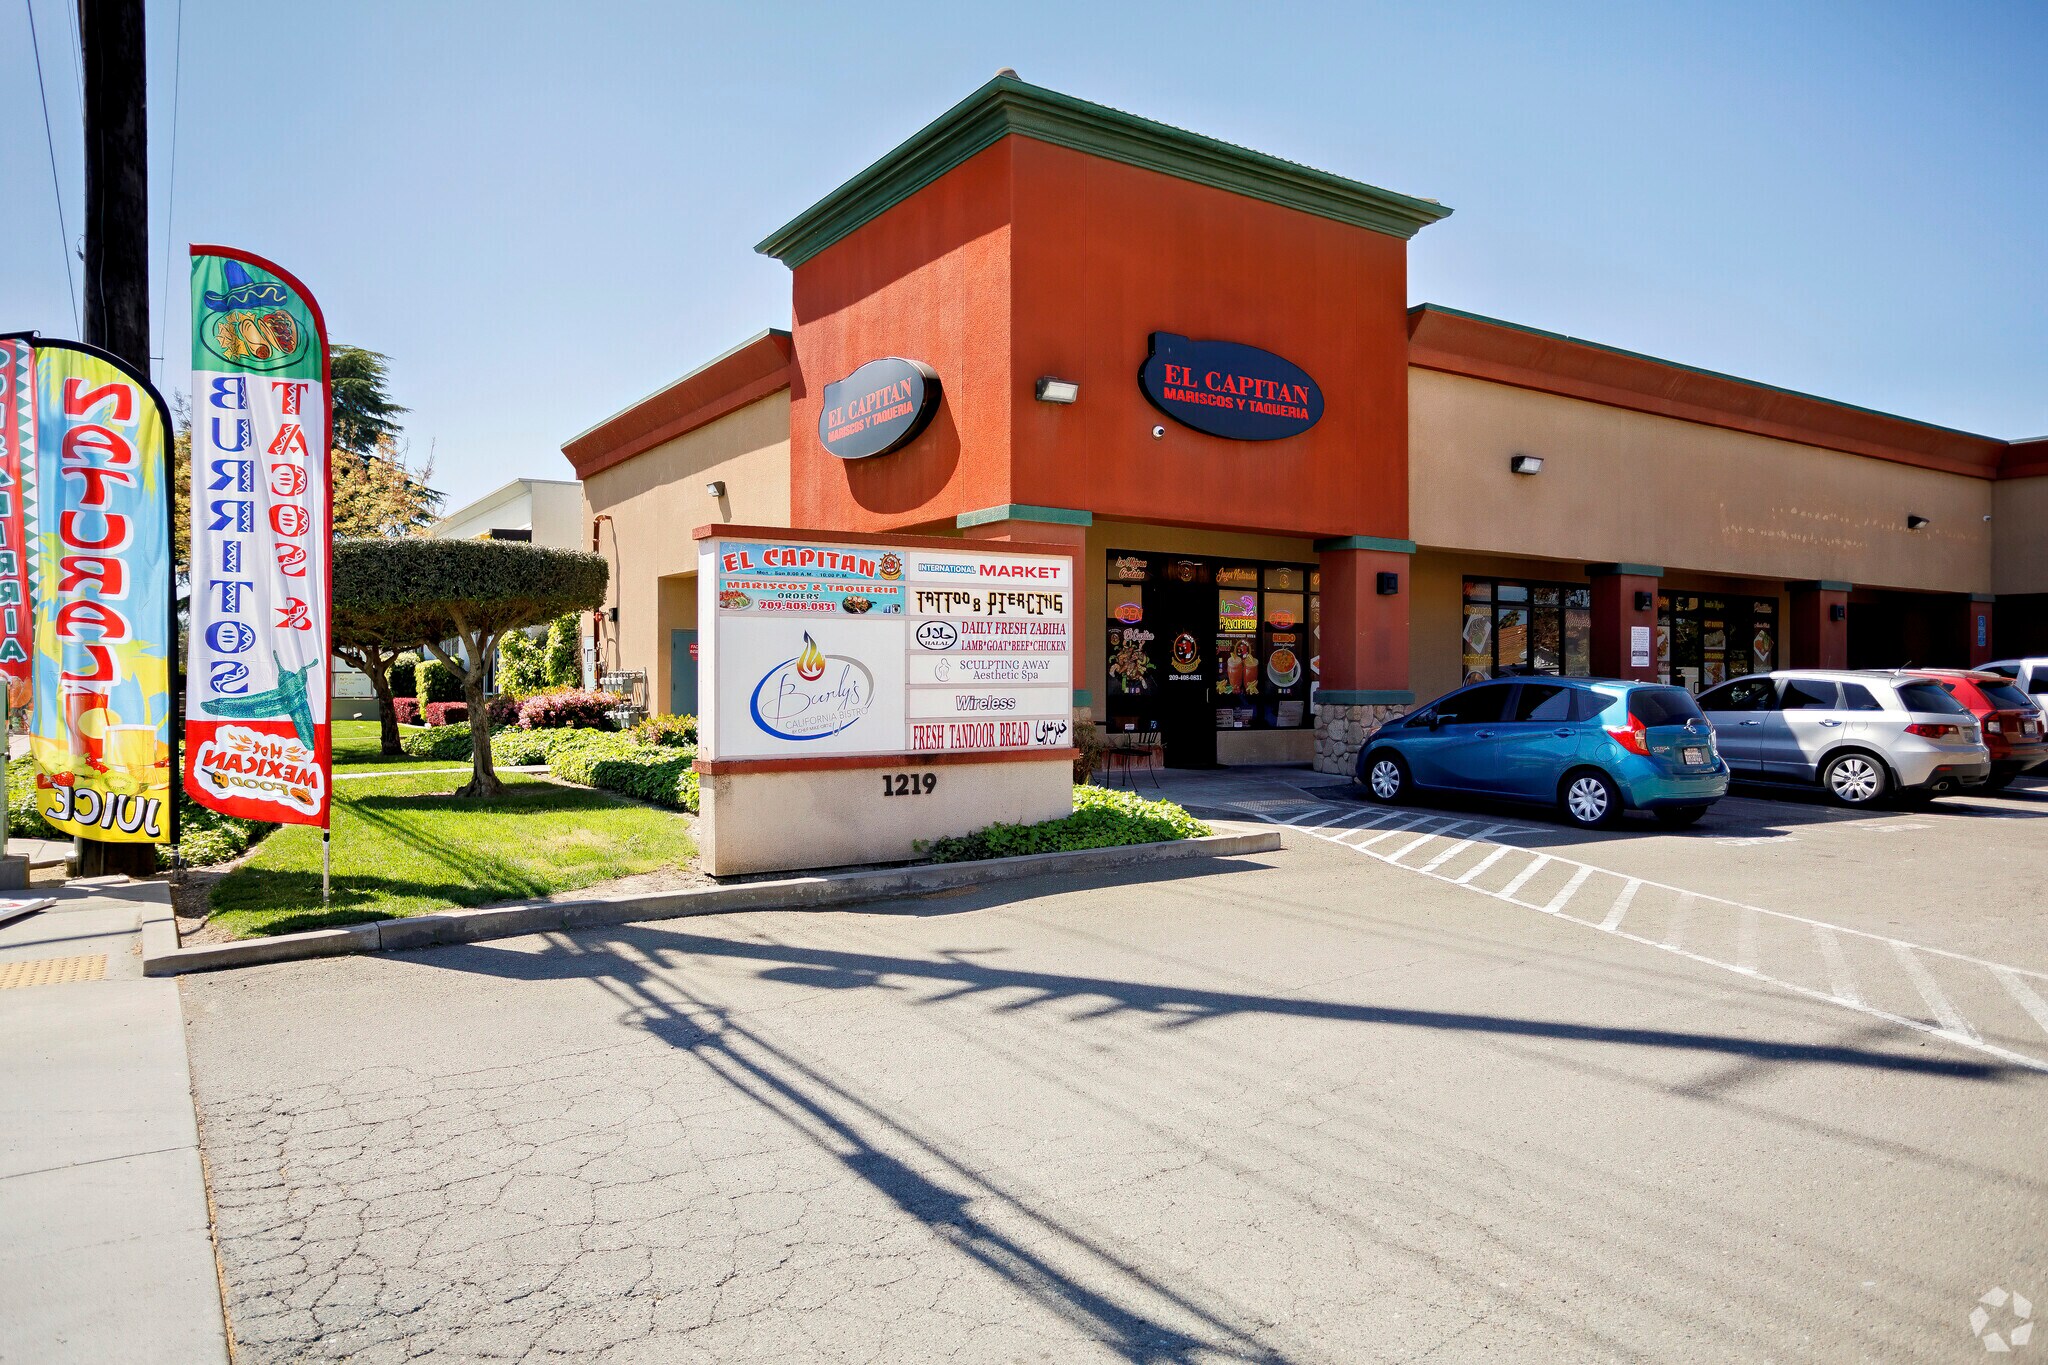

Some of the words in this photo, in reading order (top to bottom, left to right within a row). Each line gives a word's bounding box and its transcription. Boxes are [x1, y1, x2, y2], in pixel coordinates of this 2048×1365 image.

[1164, 363, 1198, 389] EL
[1205, 371, 1310, 406] CAPITAN
[827, 406, 846, 430] EL
[847, 376, 913, 421] CAPITAN
[1163, 386, 1234, 409] MARISCOS
[1235, 398, 1246, 411] Y
[1248, 400, 1310, 421] TAQUERIA
[827, 419, 865, 443] MARISCOS
[865, 416, 872, 429] Y
[872, 400, 914, 426] TAQUERIA
[723, 551, 754, 573] EL
[762, 548, 876, 578] CAPITAN
[918, 563, 976, 574] INTERNATIONAL
[979, 564, 1061, 579] MARKET
[726, 581, 808, 591] MARISCOS
[812, 583, 824, 592] &
[827, 584, 899, 594] TAQUERIA
[777, 592, 820, 600] ORDERS
[915, 591, 970, 613] TATTOO
[987, 591, 1063, 616] PIERCING
[758, 600, 837, 612] 209.408.0831
[1115, 605, 1143, 622] OPEN
[1269, 612, 1295, 626] OPEN
[920, 627, 954, 639] حلال
[961, 621, 993, 635] DAILY
[996, 622, 1028, 635] FRESH
[1030, 623, 1066, 635] ZABIHA
[959, 660, 1020, 670] SCULPTING
[1022, 660, 1050, 669] AWAY
[973, 670, 1020, 680] Aesthetic
[1021, 670, 1039, 681] Spa
[956, 695, 1016, 711] Wireless
[785, 712, 837, 730] CALIFORNIA
[839, 707, 869, 720] BISTRO
[913, 724, 945, 750] FRESH
[949, 722, 995, 749] TANDOOR
[999, 721, 1030, 747] BREAD
[882, 772, 937, 796] 1219
